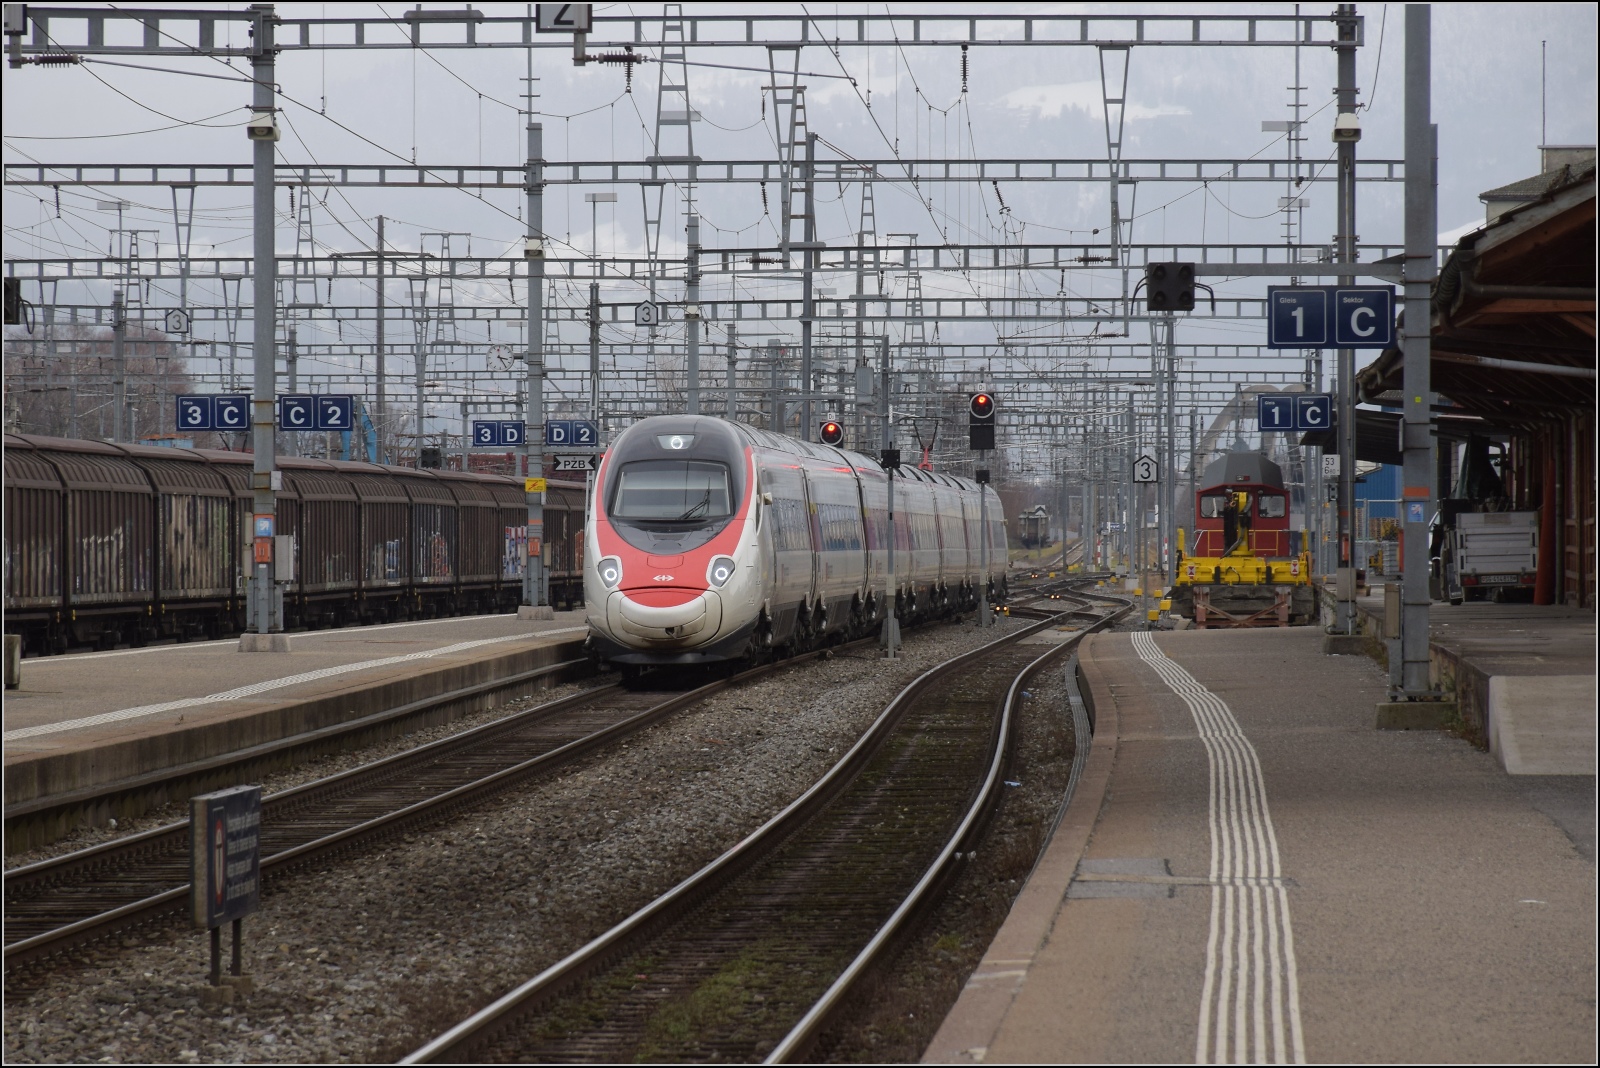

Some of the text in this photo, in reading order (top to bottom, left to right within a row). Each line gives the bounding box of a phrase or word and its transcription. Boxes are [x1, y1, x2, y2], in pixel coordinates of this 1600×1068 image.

[172, 314, 182, 330] 3
[641, 306, 652, 322] 3
[1291, 307, 1304, 337] 1
[1350, 307, 1376, 337] C
[187, 406, 202, 425] 3
[223, 406, 239, 425] C
[289, 406, 305, 425] C
[327, 406, 341, 425] 2
[1271, 406, 1280, 425] 1
[1305, 406, 1321, 425] C
[480, 428, 491, 442] 3
[506, 428, 518, 442] D
[553, 427, 565, 442] D
[579, 428, 590, 442] 2
[563, 460, 586, 469] PZB
[1325, 457, 1335, 466] 53
[1140, 462, 1151, 480] 3
